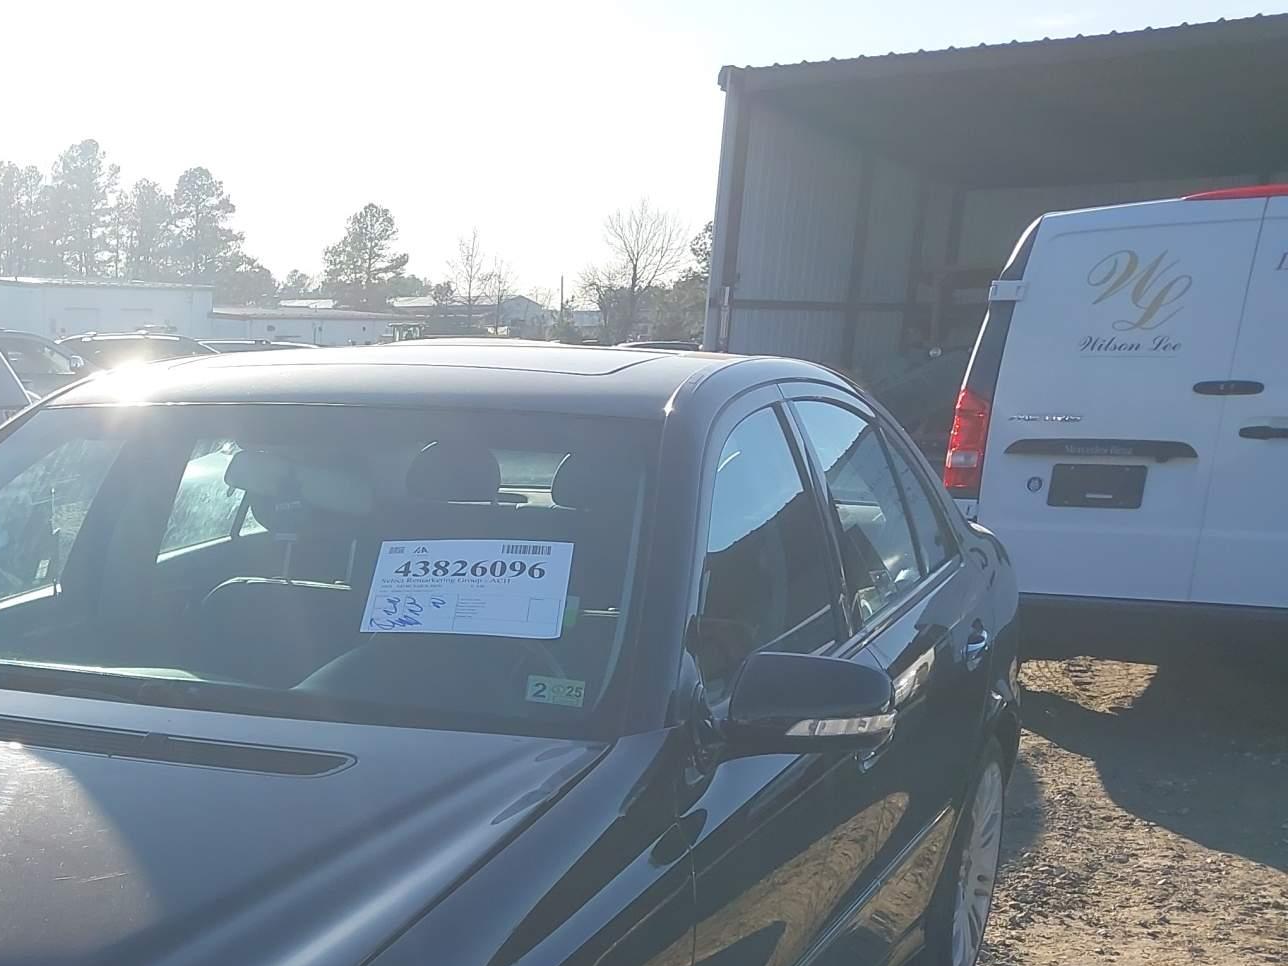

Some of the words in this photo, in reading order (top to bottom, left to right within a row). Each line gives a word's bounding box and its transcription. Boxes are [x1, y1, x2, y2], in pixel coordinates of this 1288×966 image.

[1079, 335, 1141, 352] Wilson
[1150, 335, 1182, 352] Lee
[394, 560, 546, 579] 43826096
[532, 682, 547, 698] 2
[566, 686, 583, 698] 25
